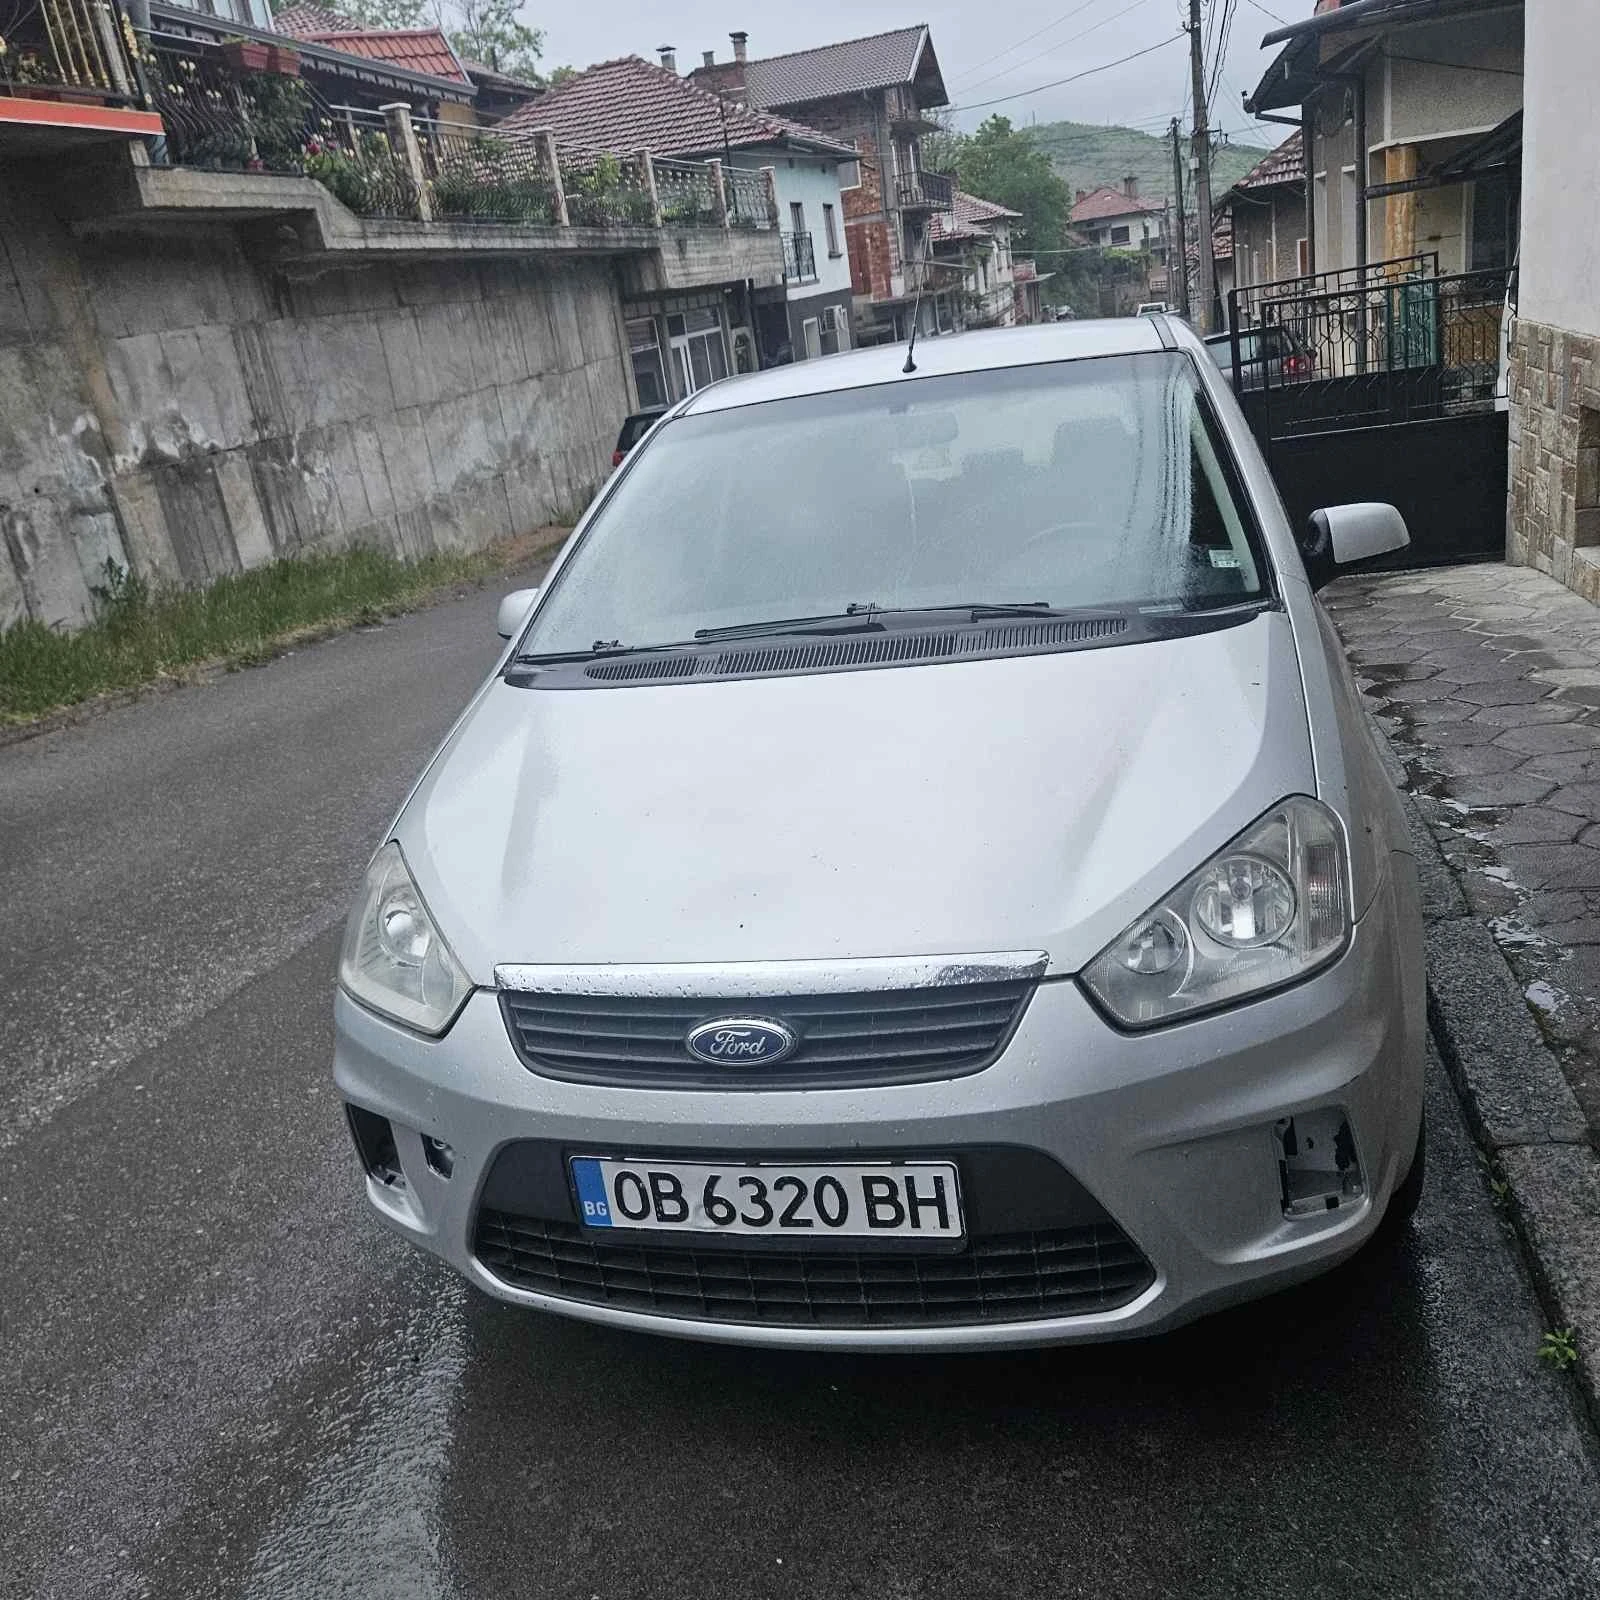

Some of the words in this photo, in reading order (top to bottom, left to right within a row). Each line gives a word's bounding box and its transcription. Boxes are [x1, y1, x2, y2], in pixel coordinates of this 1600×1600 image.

[710, 1030, 766, 1055] Ford
[584, 1201, 609, 1218] BG
[613, 1170, 689, 1223] OB
[703, 1174, 850, 1228] 6320
[861, 1175, 951, 1230] BH
